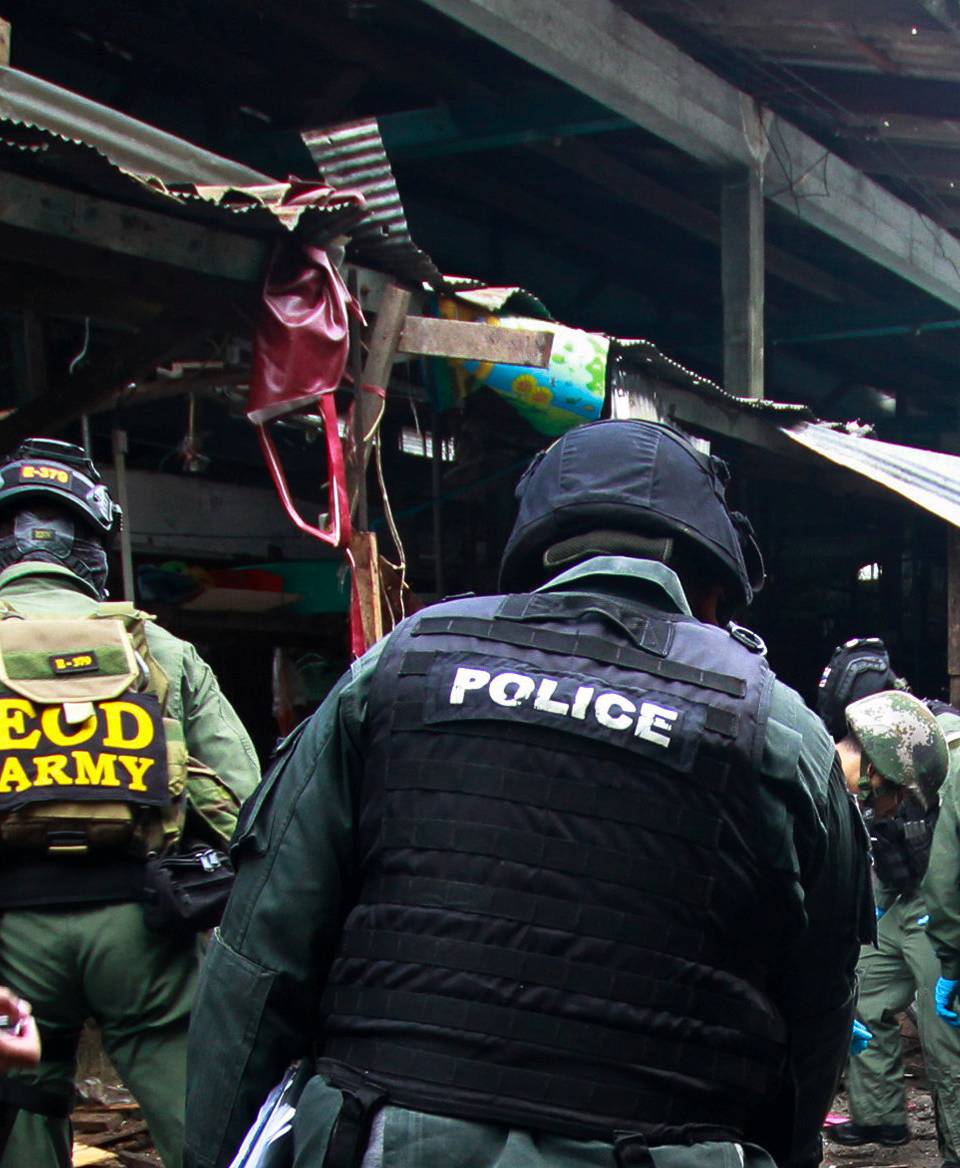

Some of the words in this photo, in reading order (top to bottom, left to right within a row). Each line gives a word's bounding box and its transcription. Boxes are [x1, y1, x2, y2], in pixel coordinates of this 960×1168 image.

[0, 698, 154, 750] EOD
[450, 667, 678, 748] POLICE
[0, 750, 155, 792] ARMY
